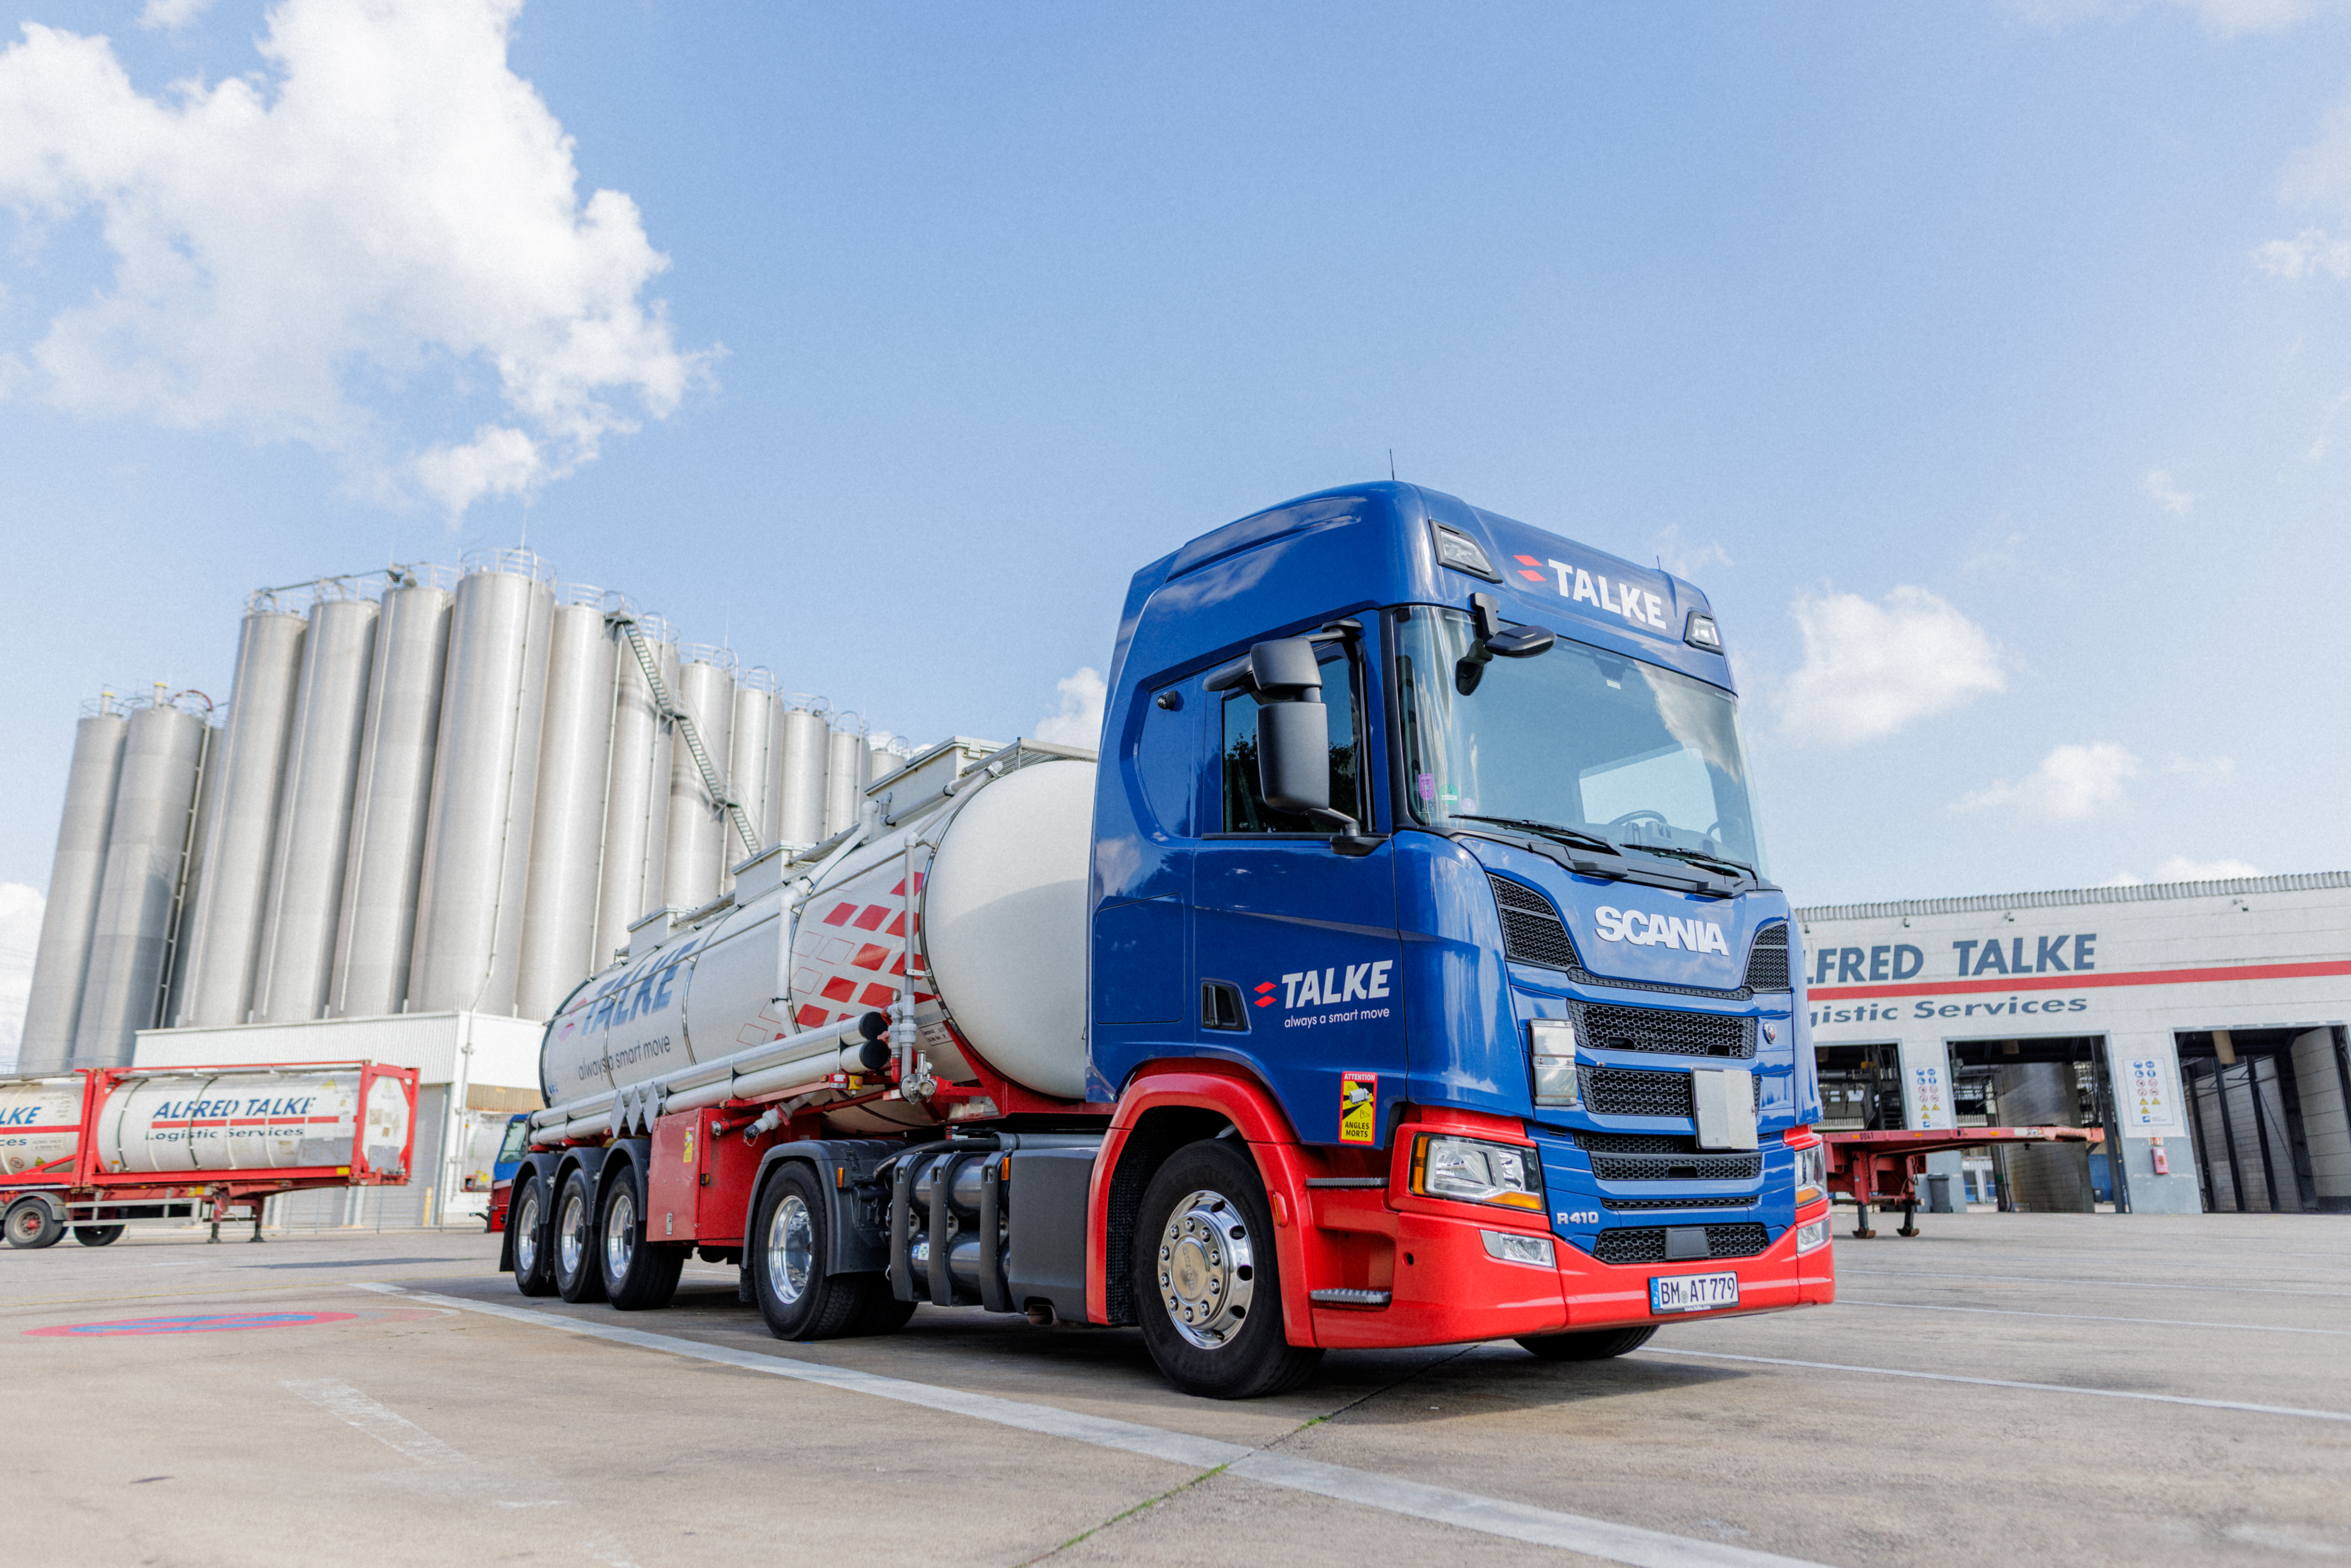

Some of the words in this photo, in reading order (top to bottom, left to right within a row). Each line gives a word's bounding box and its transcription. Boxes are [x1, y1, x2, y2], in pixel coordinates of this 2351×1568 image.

[1548, 559, 1666, 630] TALKE
[1595, 905, 1729, 956] SCANIA
[1952, 933, 2097, 977] TALKE
[580, 937, 701, 1037] TALKE
[1282, 959, 1393, 1009] TALKE
[1284, 1015, 1317, 1029] always
[1319, 1015, 1326, 1024] a
[1329, 1009, 1358, 1023] smart
[1360, 1008, 1390, 1020] move
[1913, 996, 2088, 1019] Services
[578, 1057, 607, 1081] always
[615, 1039, 642, 1070] smart
[643, 1035, 671, 1060] move
[153, 1099, 239, 1119] ALFRED
[246, 1097, 317, 1116] TALKE
[145, 1129, 218, 1142] Logistic
[225, 1128, 305, 1138] Services
[1345, 1121, 1369, 1130] ANGLES
[1346, 1129, 1368, 1137] MORTS
[1859, 1132, 1873, 1140] 0041
[1661, 1281, 1680, 1305] BM
[1691, 1279, 1706, 1302] AT
[1710, 1276, 1735, 1300] 779
